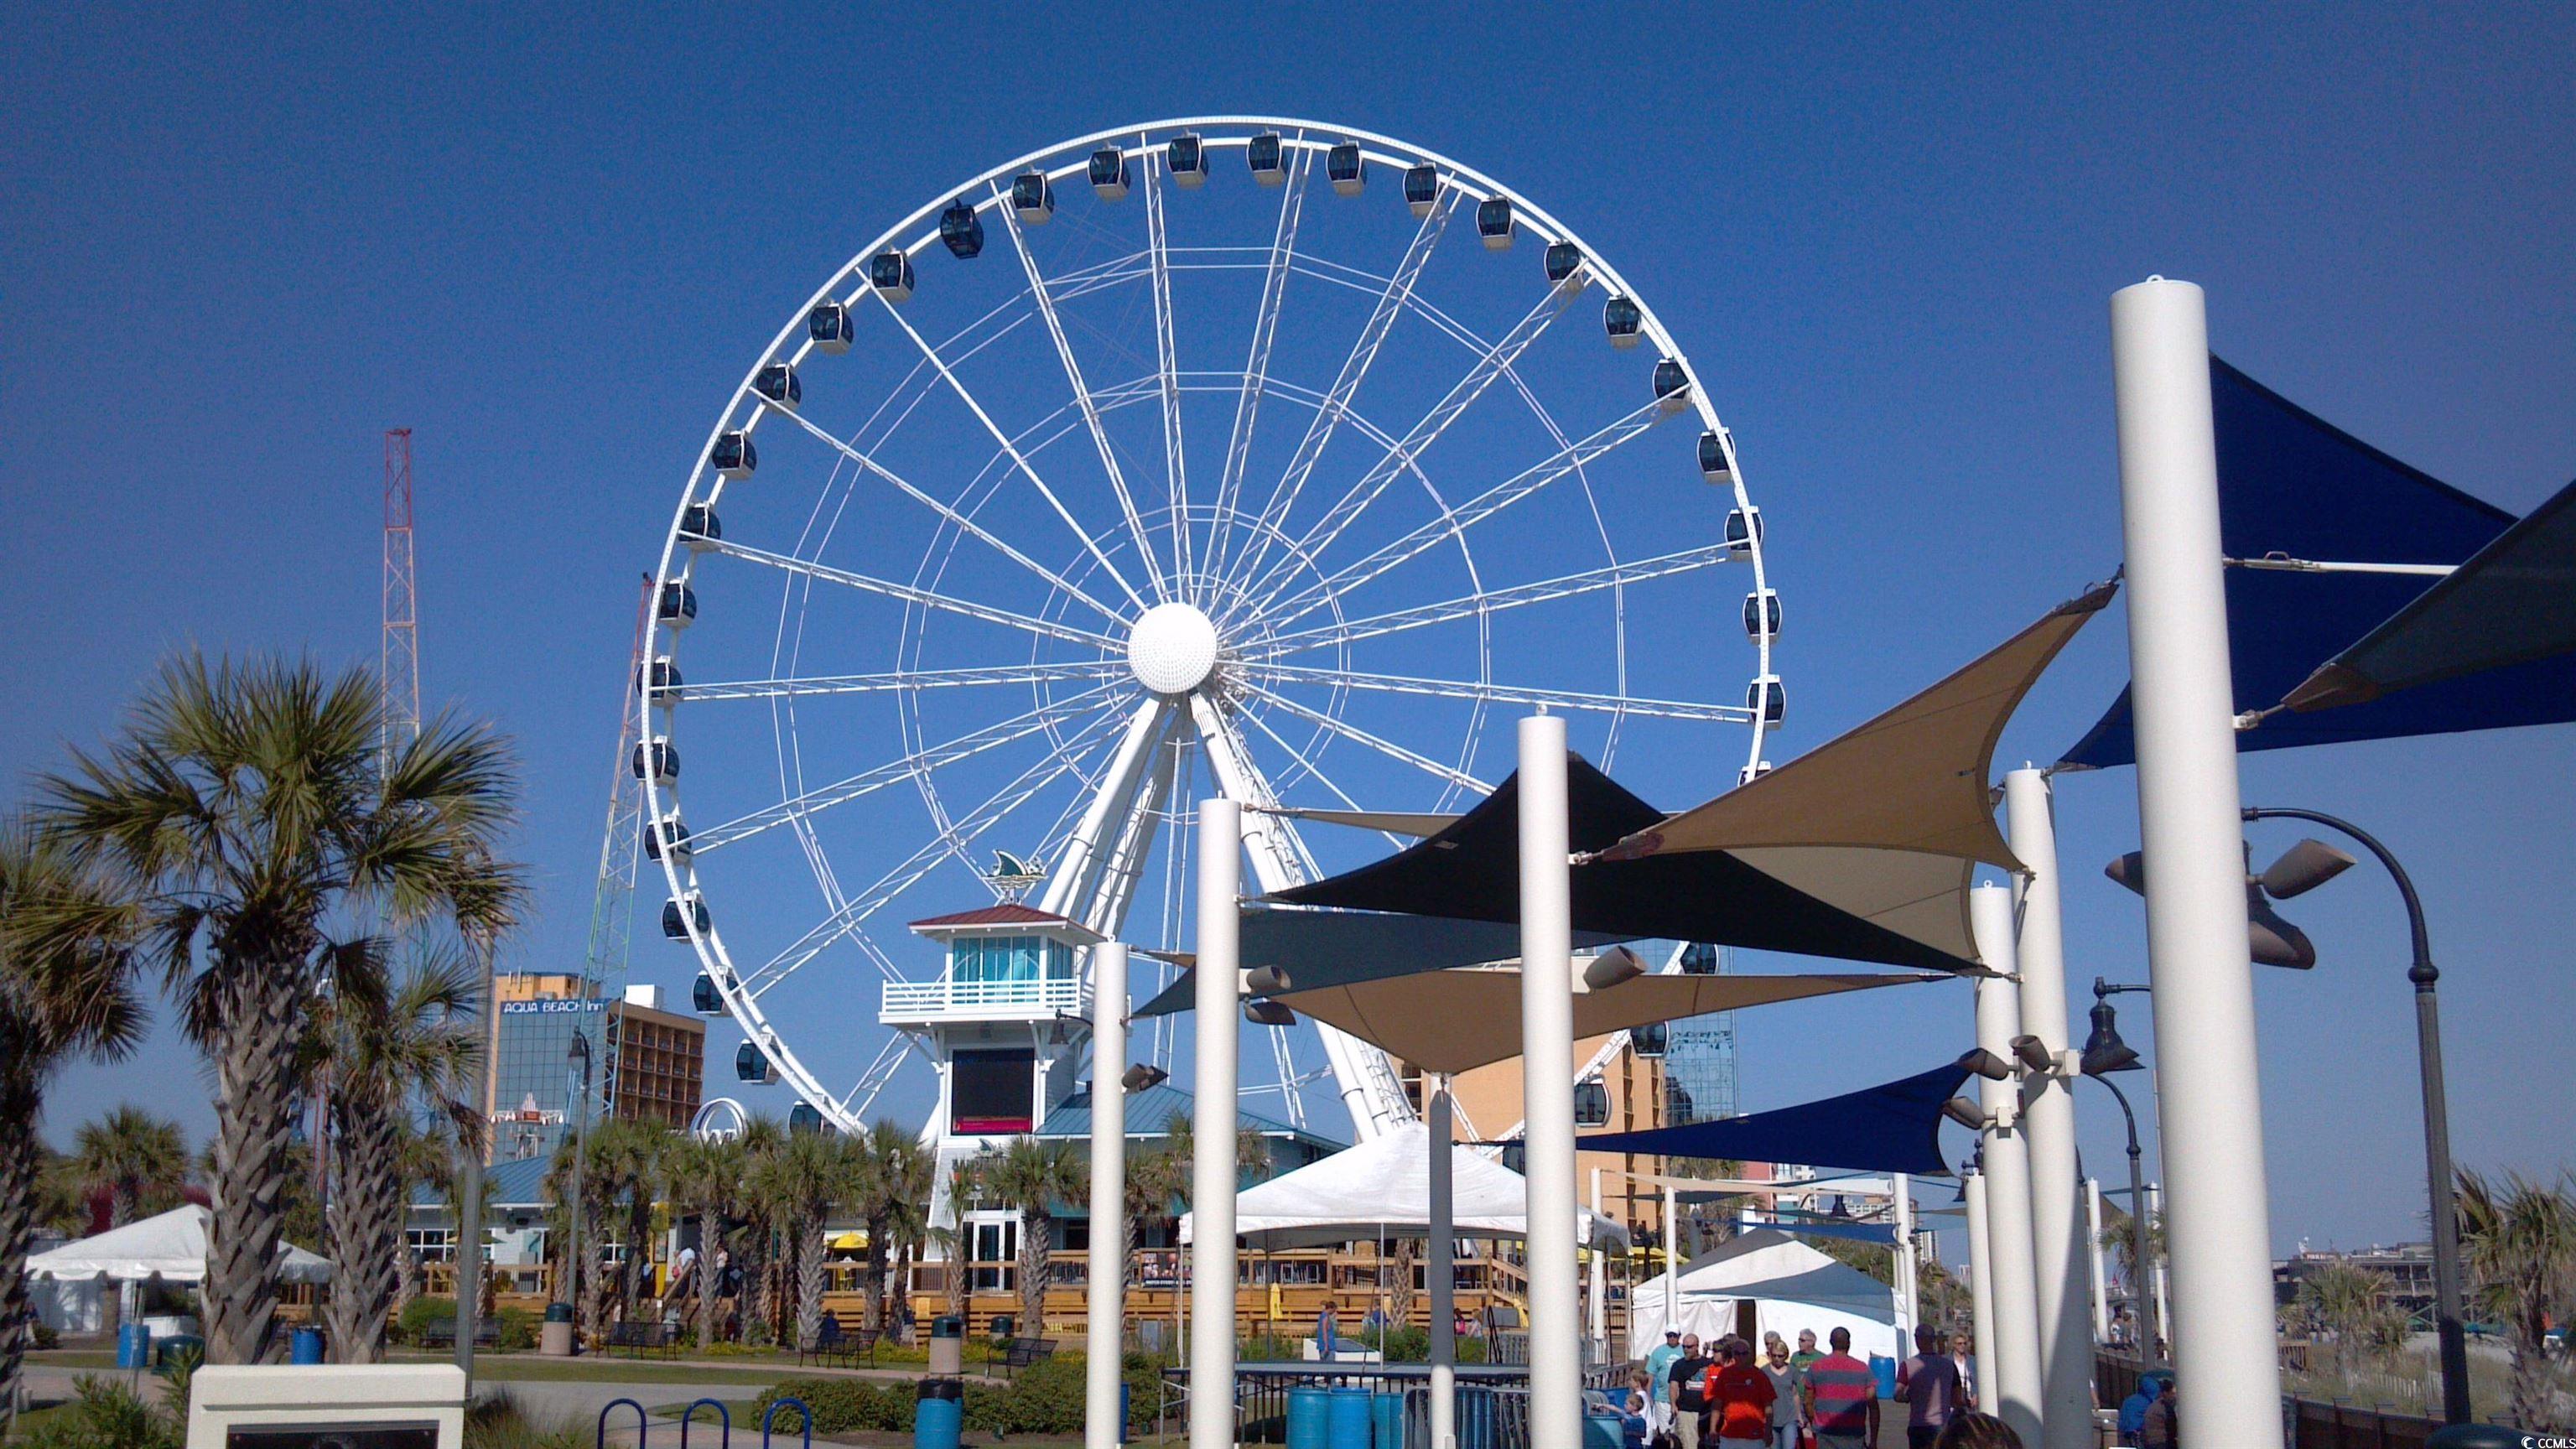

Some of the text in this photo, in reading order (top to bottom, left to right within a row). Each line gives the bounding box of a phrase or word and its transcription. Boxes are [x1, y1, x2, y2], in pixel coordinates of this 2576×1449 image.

[504, 1000, 604, 1013] AQUA BEACH Inn
